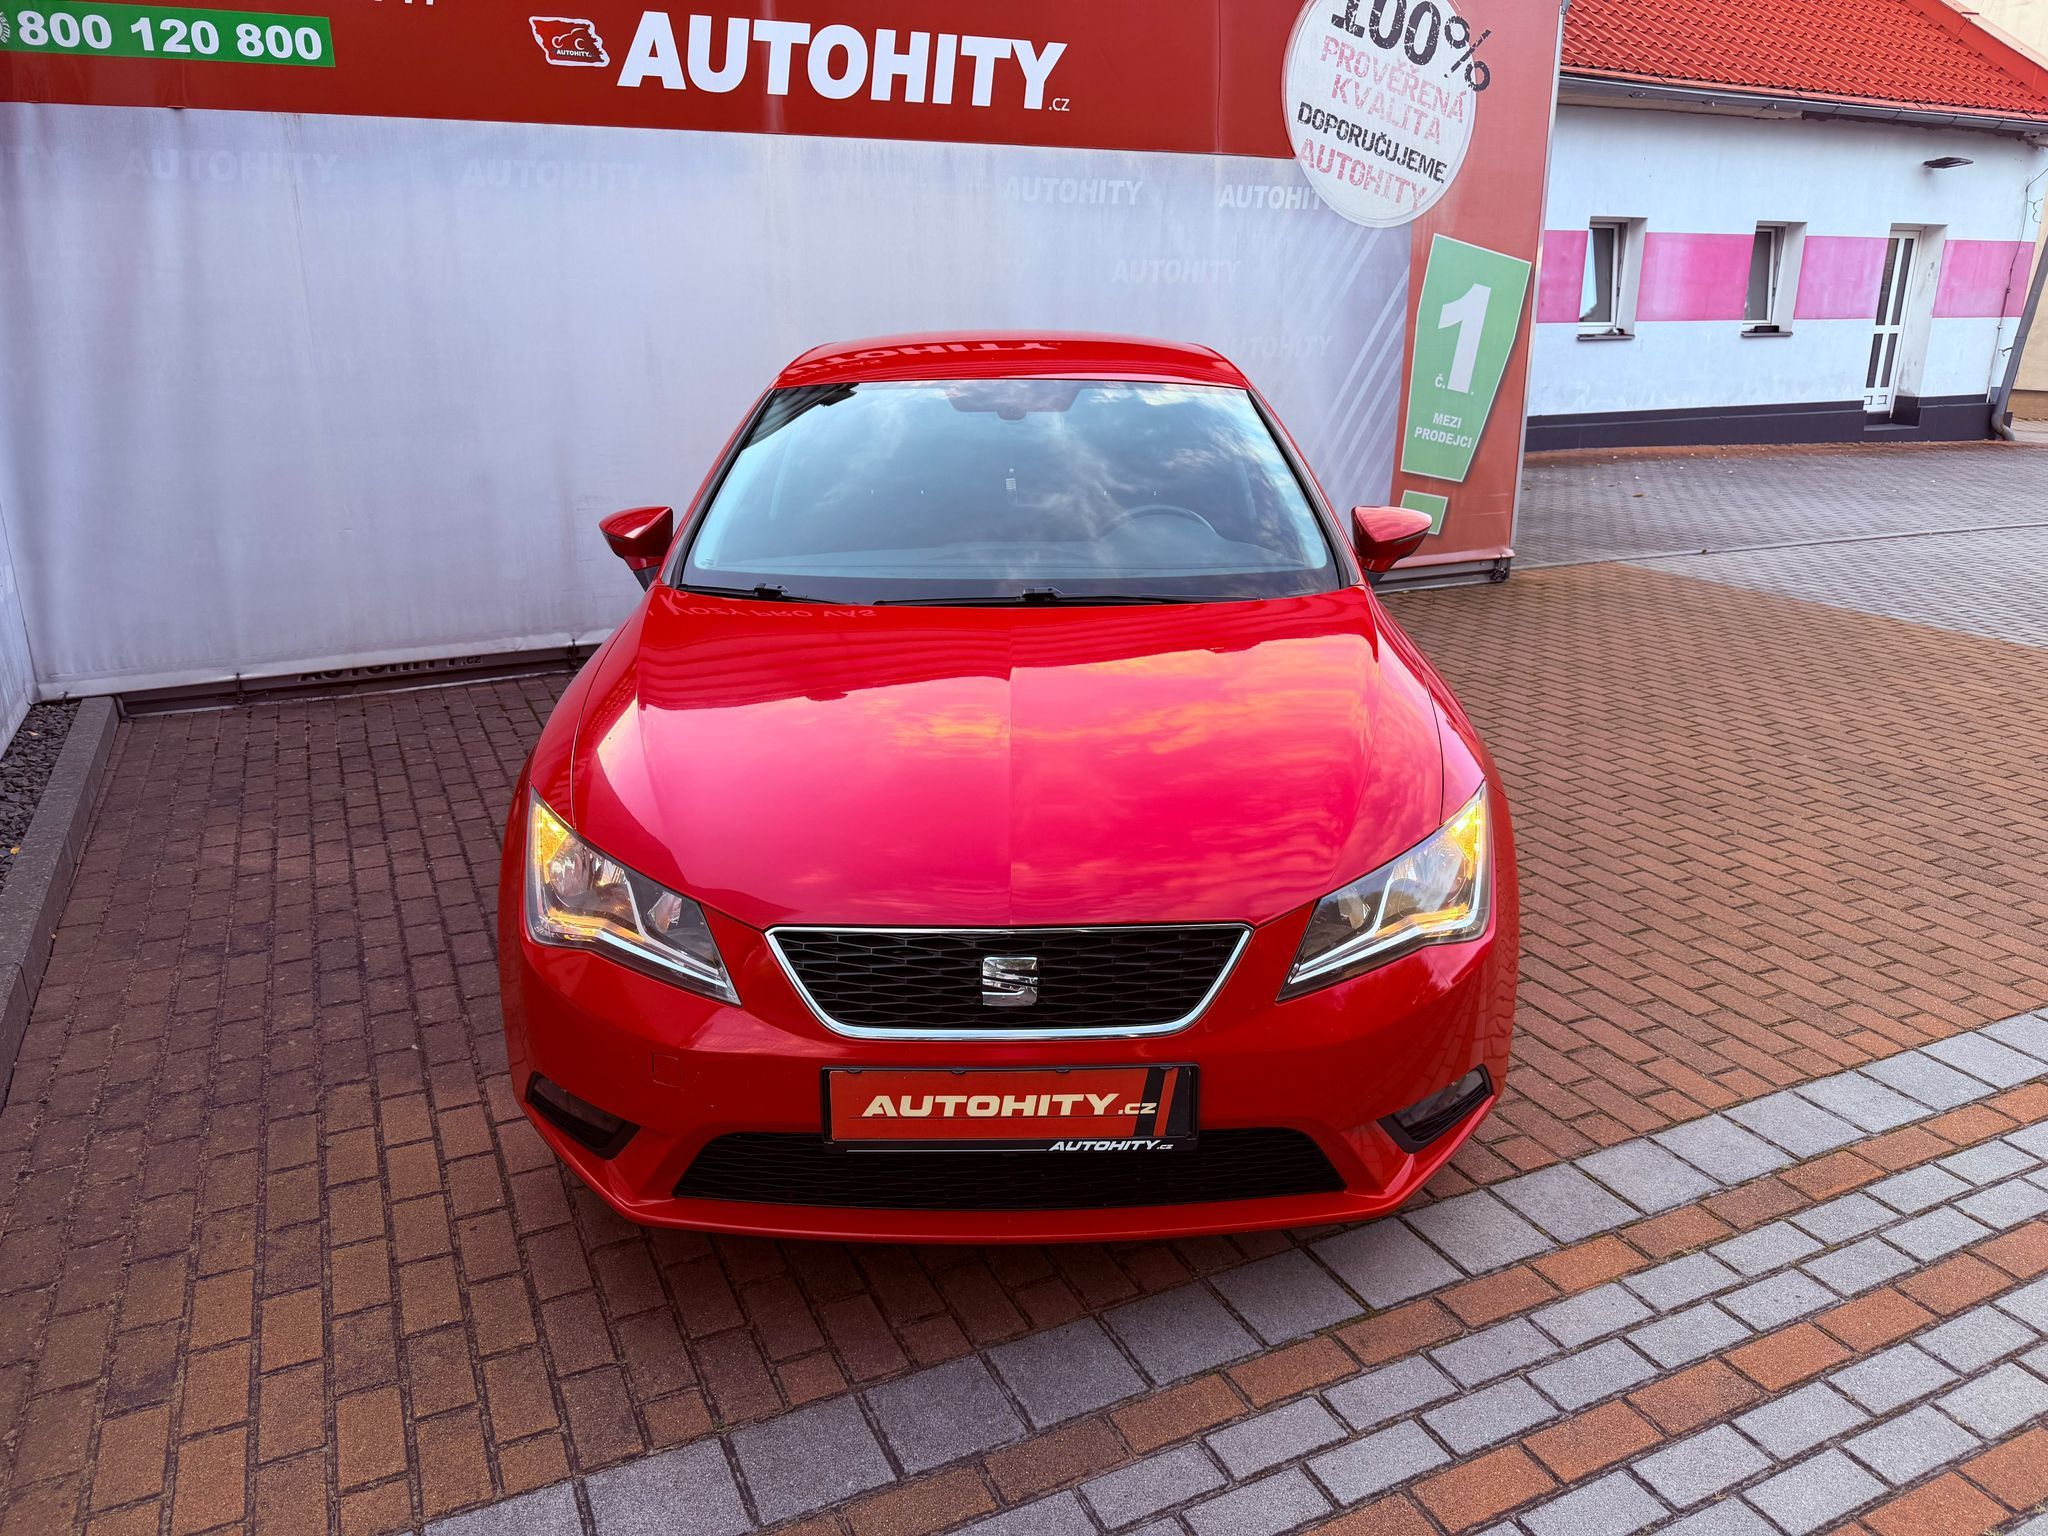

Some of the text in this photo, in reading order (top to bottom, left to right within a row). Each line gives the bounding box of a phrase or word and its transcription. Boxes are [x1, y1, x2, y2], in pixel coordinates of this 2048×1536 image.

[17, 10, 322, 60] 800 120 800
[1331, 0, 1492, 92] 100%
[1320, 35, 1467, 124] PROVĚŘENÁ
[1331, 74, 1441, 145] KVALITA
[1297, 101, 1448, 184] DOPORUČUJEME
[460, 158, 647, 191] AUTOHITY
[1002, 175, 1145, 206] AUTOHITY
[1300, 138, 1427, 211] AUTOHITY
[1218, 184, 1335, 211] AUTOHIT
[1111, 258, 1242, 284] AUTOHITY
[1432, 412, 1462, 429] MEZI
[1414, 426, 1473, 449] PRODEJCI
[861, 1093, 1157, 1117] AUTOHITY.cz
[1048, 1139, 1174, 1152] AUTOHITY.cz
